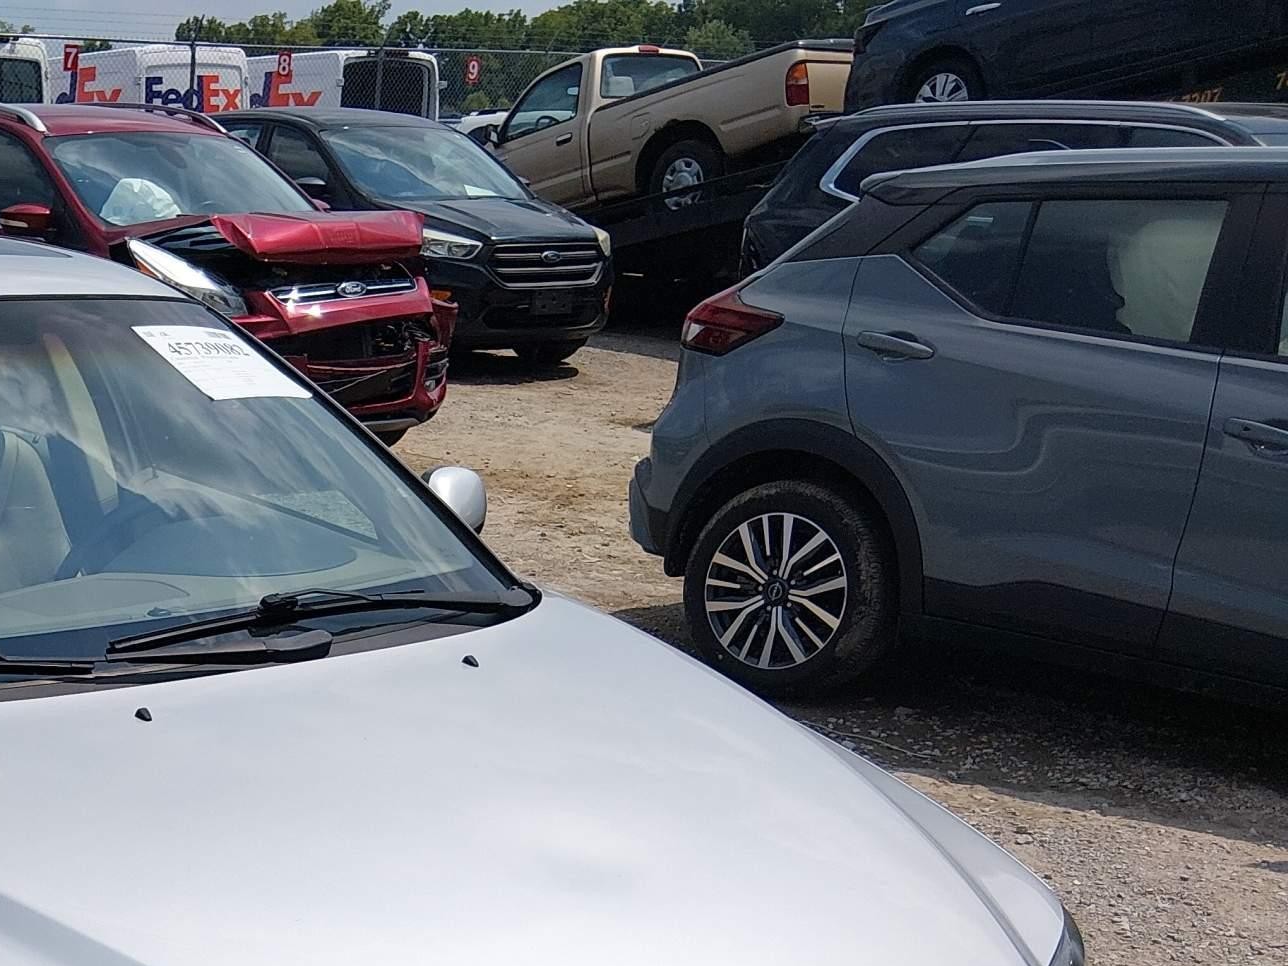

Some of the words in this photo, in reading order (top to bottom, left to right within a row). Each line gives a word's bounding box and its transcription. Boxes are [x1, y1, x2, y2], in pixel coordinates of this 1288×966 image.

[66, 48, 77, 68] 7
[279, 55, 289, 75] 8
[468, 60, 478, 79] 9
[145, 75, 242, 117] FedEx
[168, 341, 251, 357] 45739082
